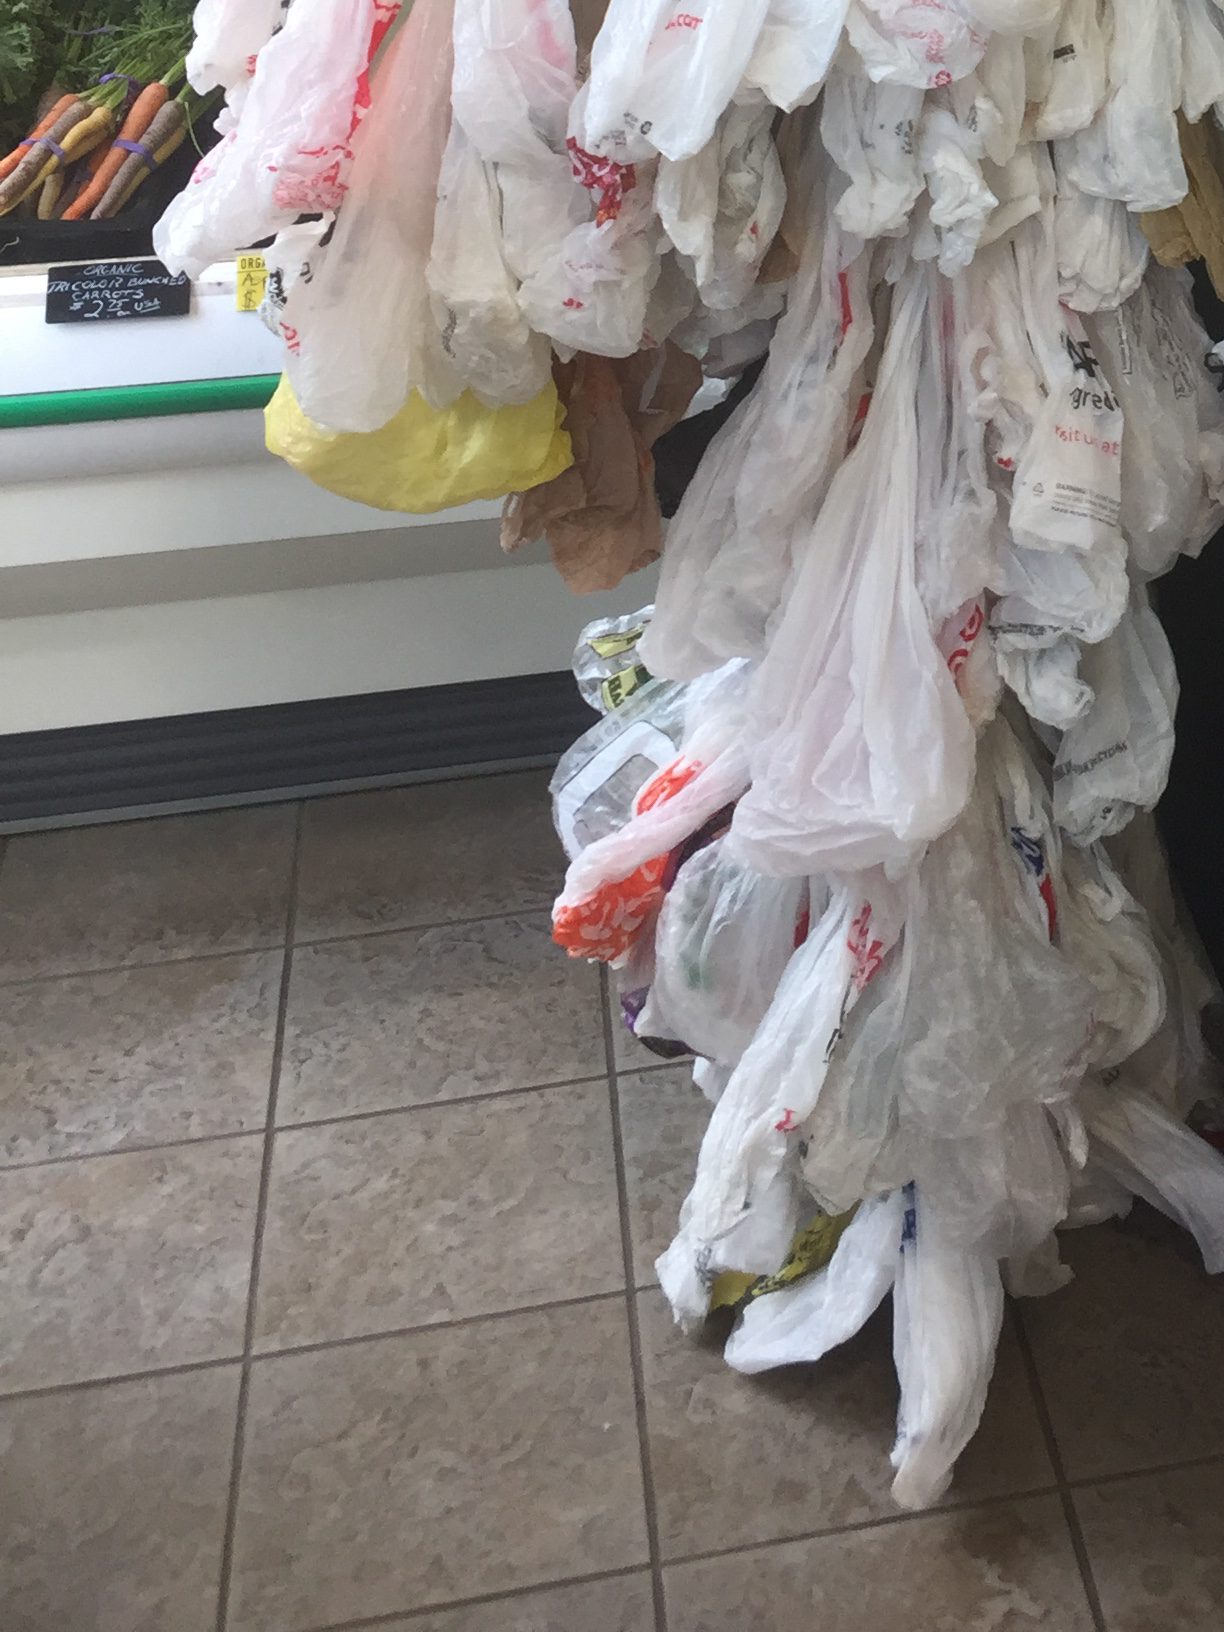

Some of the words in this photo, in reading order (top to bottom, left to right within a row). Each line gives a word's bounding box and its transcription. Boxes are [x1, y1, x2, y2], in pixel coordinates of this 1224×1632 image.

[84, 263, 145, 276] ORGANIC
[127, 275, 187, 288] BUNCHED
[71, 289, 144, 302] CARROTS
